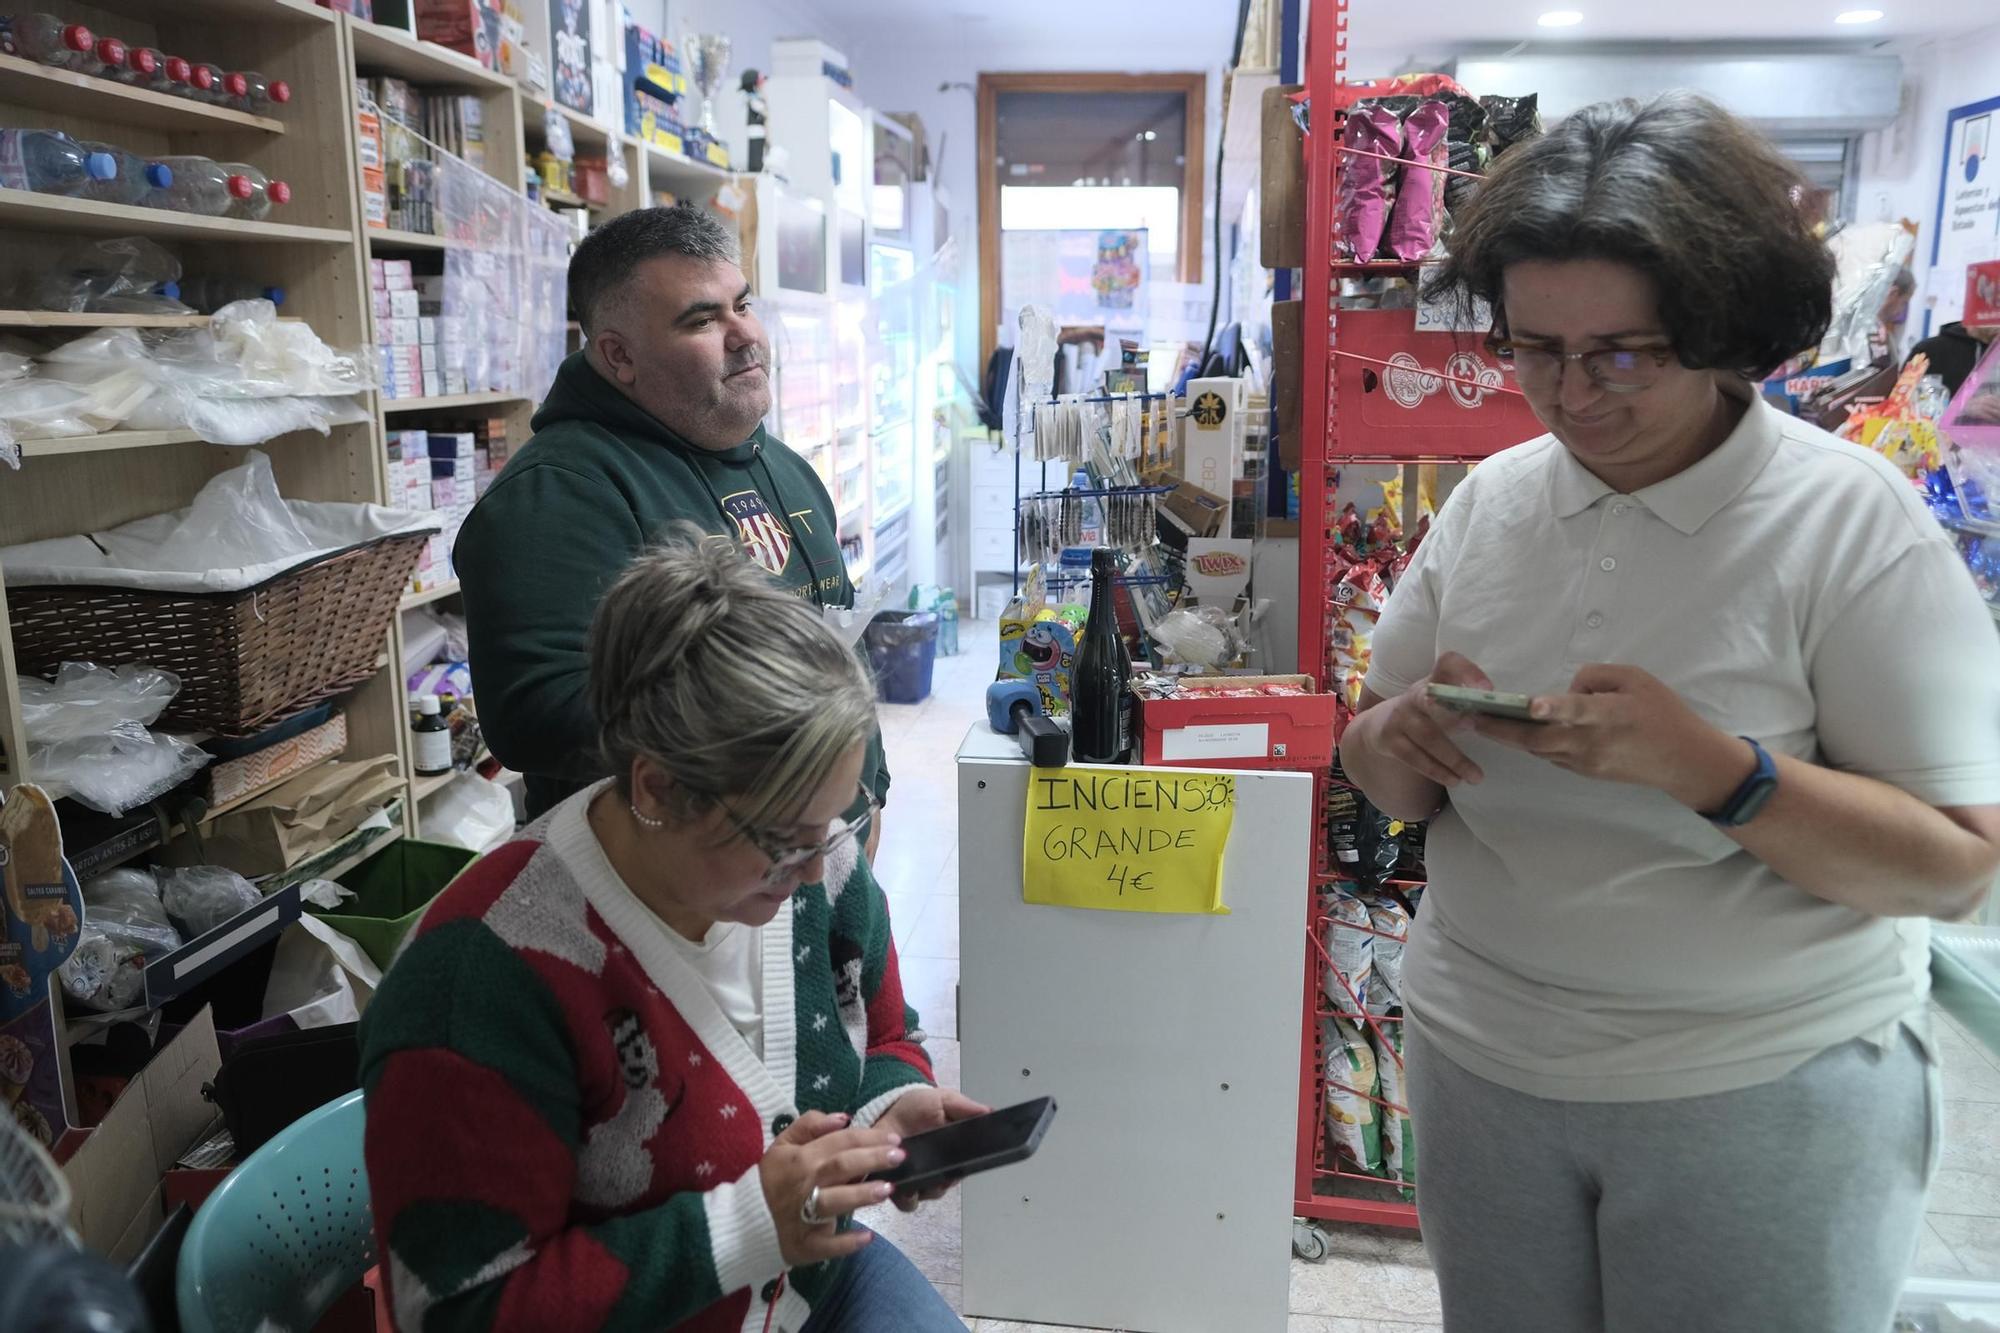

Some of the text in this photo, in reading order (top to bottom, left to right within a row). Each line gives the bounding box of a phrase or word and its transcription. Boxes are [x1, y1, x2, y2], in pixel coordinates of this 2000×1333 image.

[732, 496, 764, 515] 1949
[1037, 773, 1233, 812] INCIENSO
[1043, 824, 1197, 861] GRANDE
[1106, 863, 1154, 896] 4€
